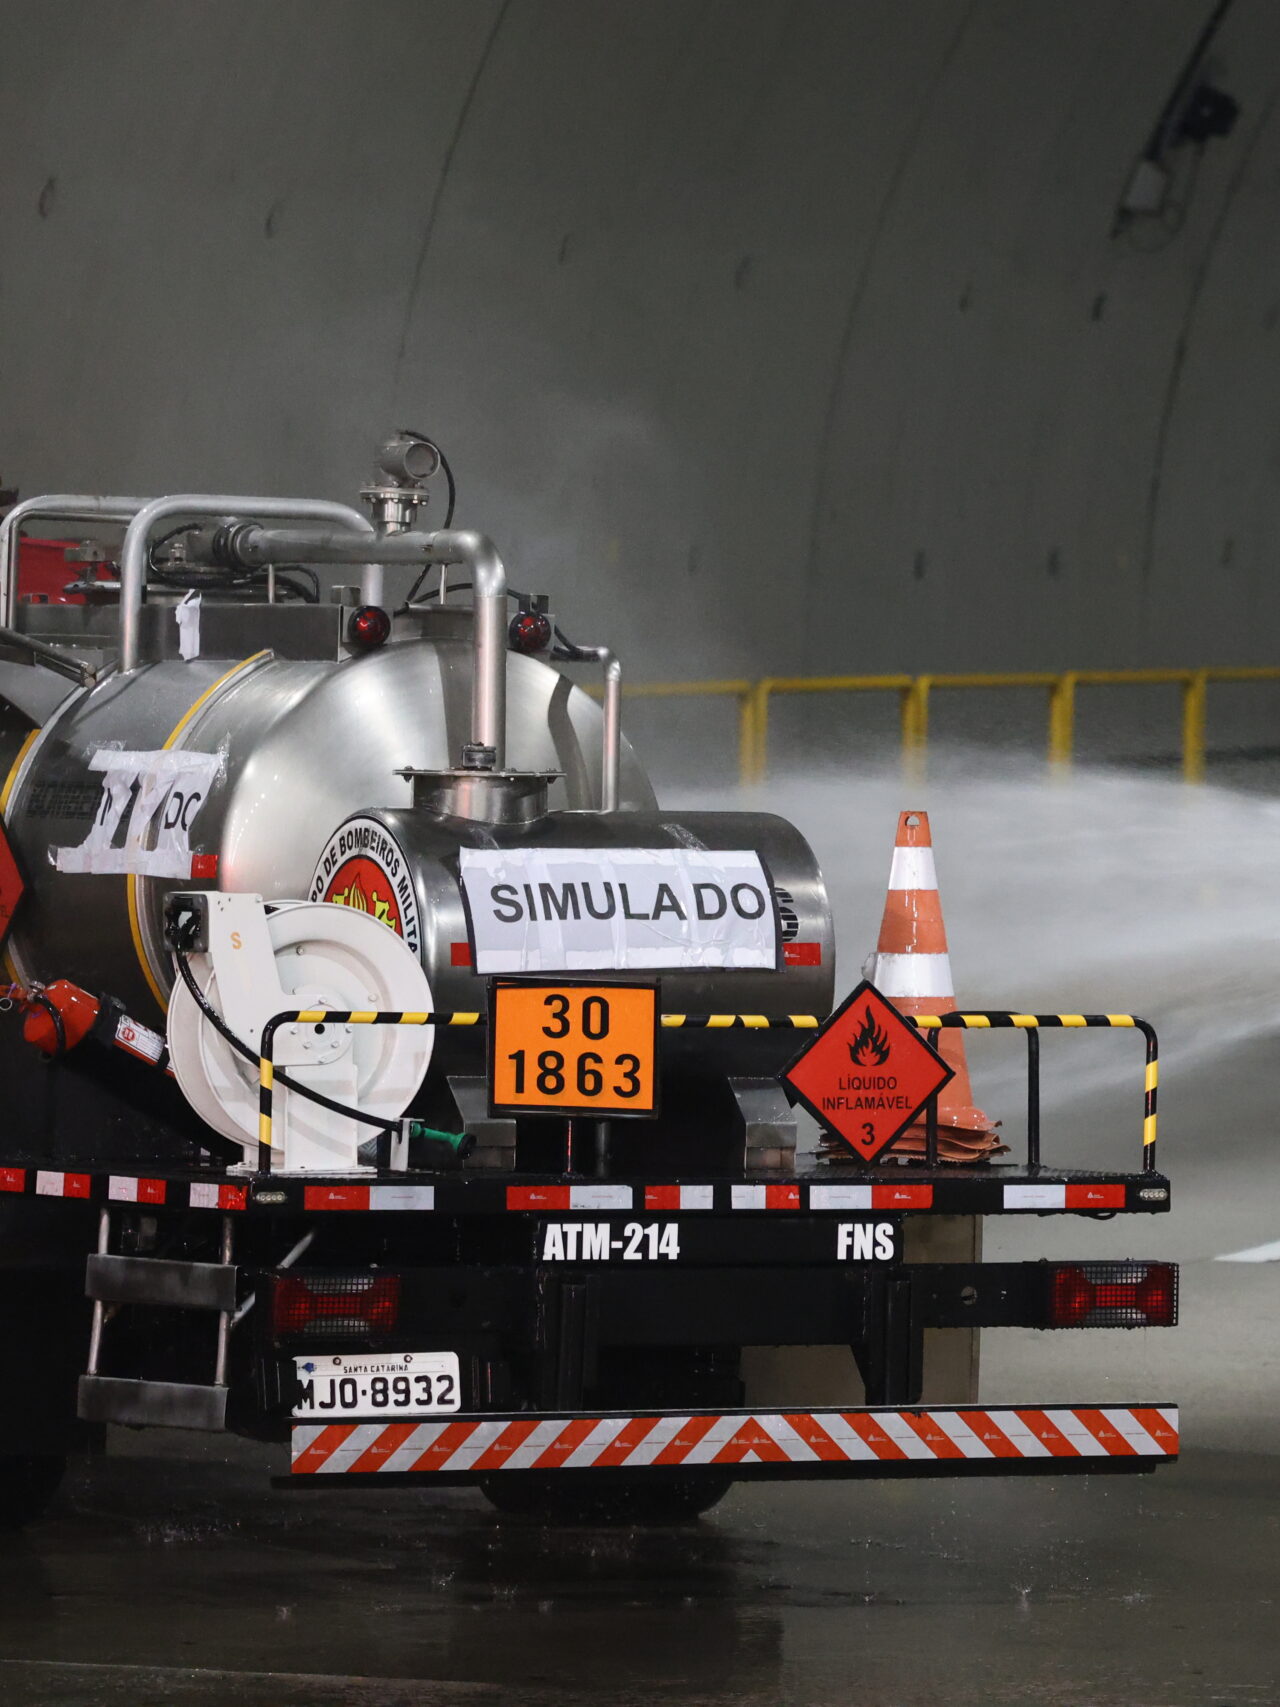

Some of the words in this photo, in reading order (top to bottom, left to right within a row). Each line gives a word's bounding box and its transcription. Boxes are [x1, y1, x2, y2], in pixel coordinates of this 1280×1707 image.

[323, 846, 338, 875] DE
[339, 828, 399, 877] BOMBEIROS
[490, 882, 766, 923] SIMULADO
[542, 994, 610, 1040] 30
[508, 1050, 641, 1098] 1863
[838, 1073, 898, 1091] LÍQUIDO
[822, 1093, 913, 1111] INFLAMÁVEL
[861, 1122, 876, 1146] 3
[542, 1222, 681, 1261] ATM-214
[836, 1222, 895, 1261] FNS
[343, 1365, 368, 1374] SANTA
[370, 1364, 409, 1373] CATARINA
